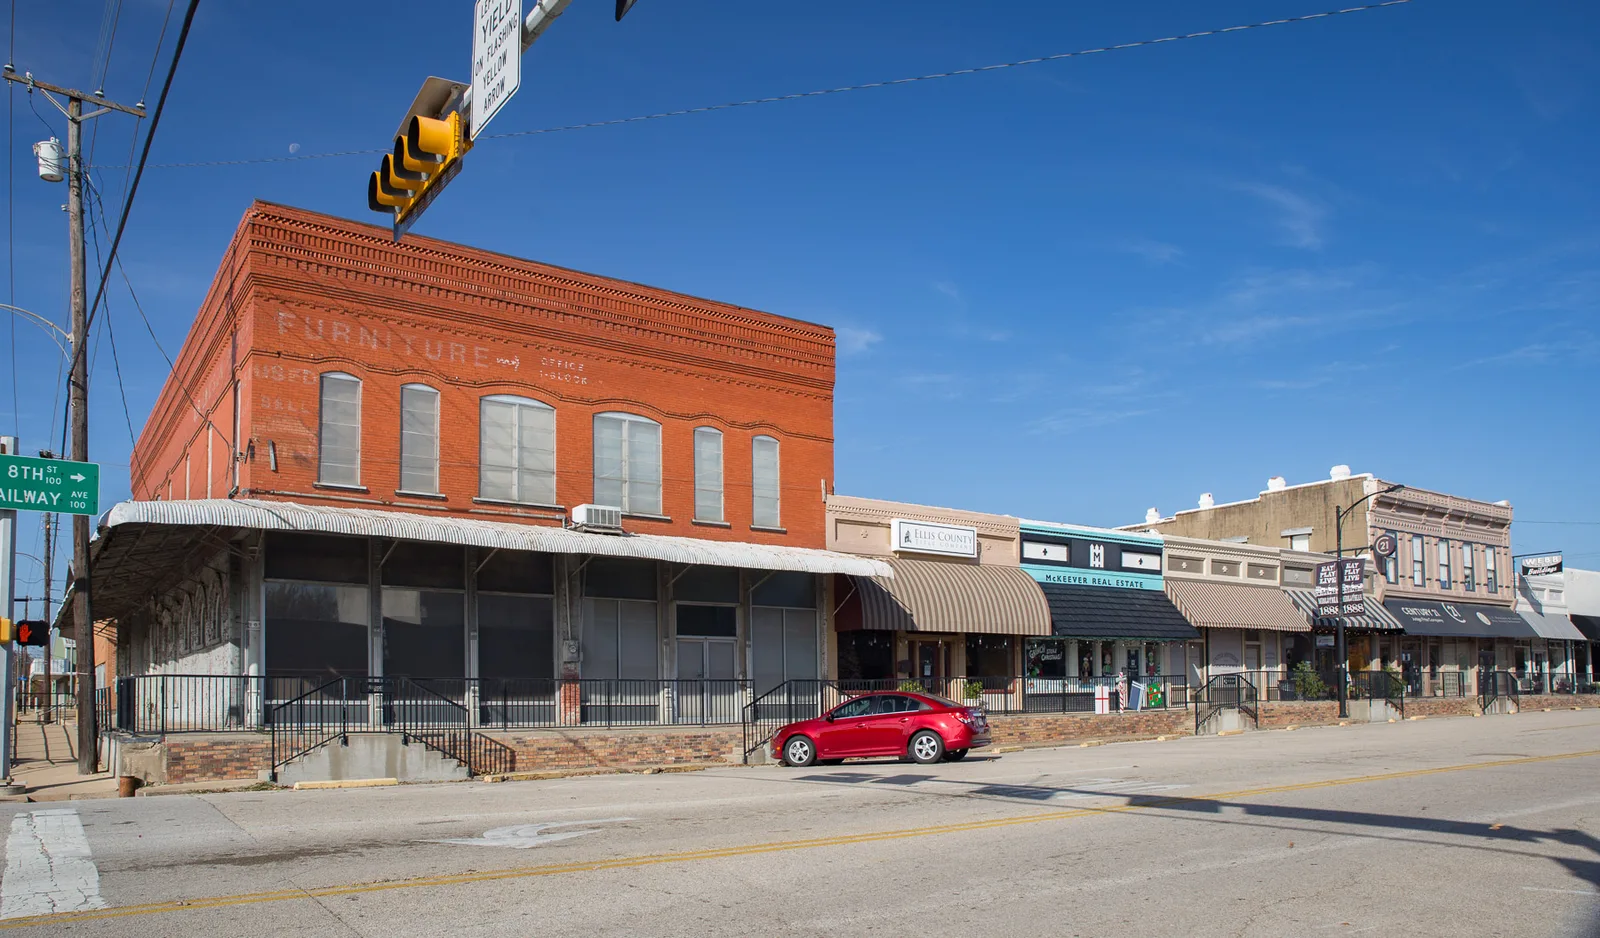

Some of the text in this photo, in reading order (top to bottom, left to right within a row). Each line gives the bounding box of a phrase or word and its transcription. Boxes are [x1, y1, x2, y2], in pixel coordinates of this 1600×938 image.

[481, 0, 494, 19] LEF
[482, 0, 512, 44] YIELD
[475, 13, 518, 77] ON FLASHING
[483, 48, 508, 90] YELLOW
[483, 76, 506, 114] ARROW
[278, 310, 489, 368] FURNITURE
[541, 356, 585, 372] OFFICE
[8, 465, 58, 481] 8TH ST
[45, 477, 62, 485] 100
[70, 491, 88, 499] AVE
[70, 501, 86, 509] 100
[914, 529, 973, 544] ELLIS COUNTY
[1525, 556, 1559, 565] WEBB
[1045, 574, 1144, 588] McKEEVER REAL ESTATE
[1343, 603, 1364, 614] 1888
[1401, 607, 1434, 617] CENTURY
